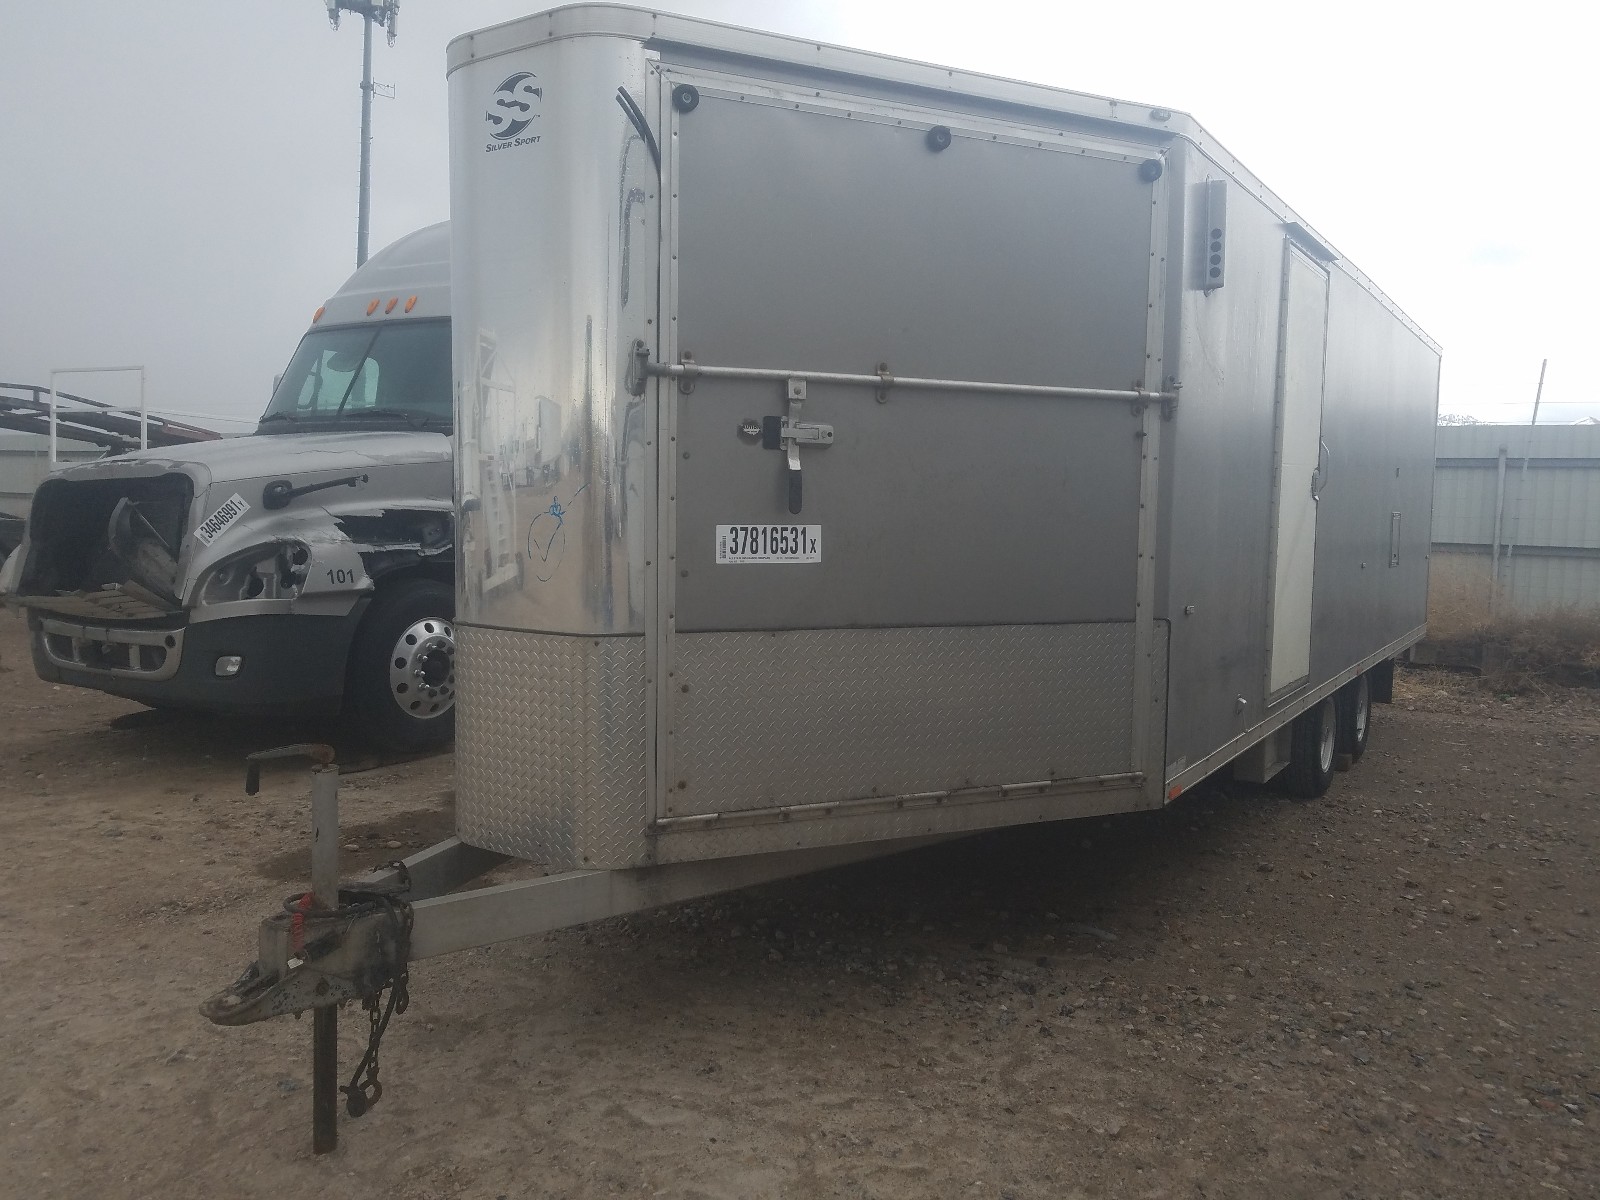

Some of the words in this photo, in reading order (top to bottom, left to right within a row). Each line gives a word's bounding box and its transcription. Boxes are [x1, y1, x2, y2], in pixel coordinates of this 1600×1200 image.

[199, 499, 242, 539] 34646991
[729, 526, 807, 555] 37816531
[326, 568, 354, 585] 101
